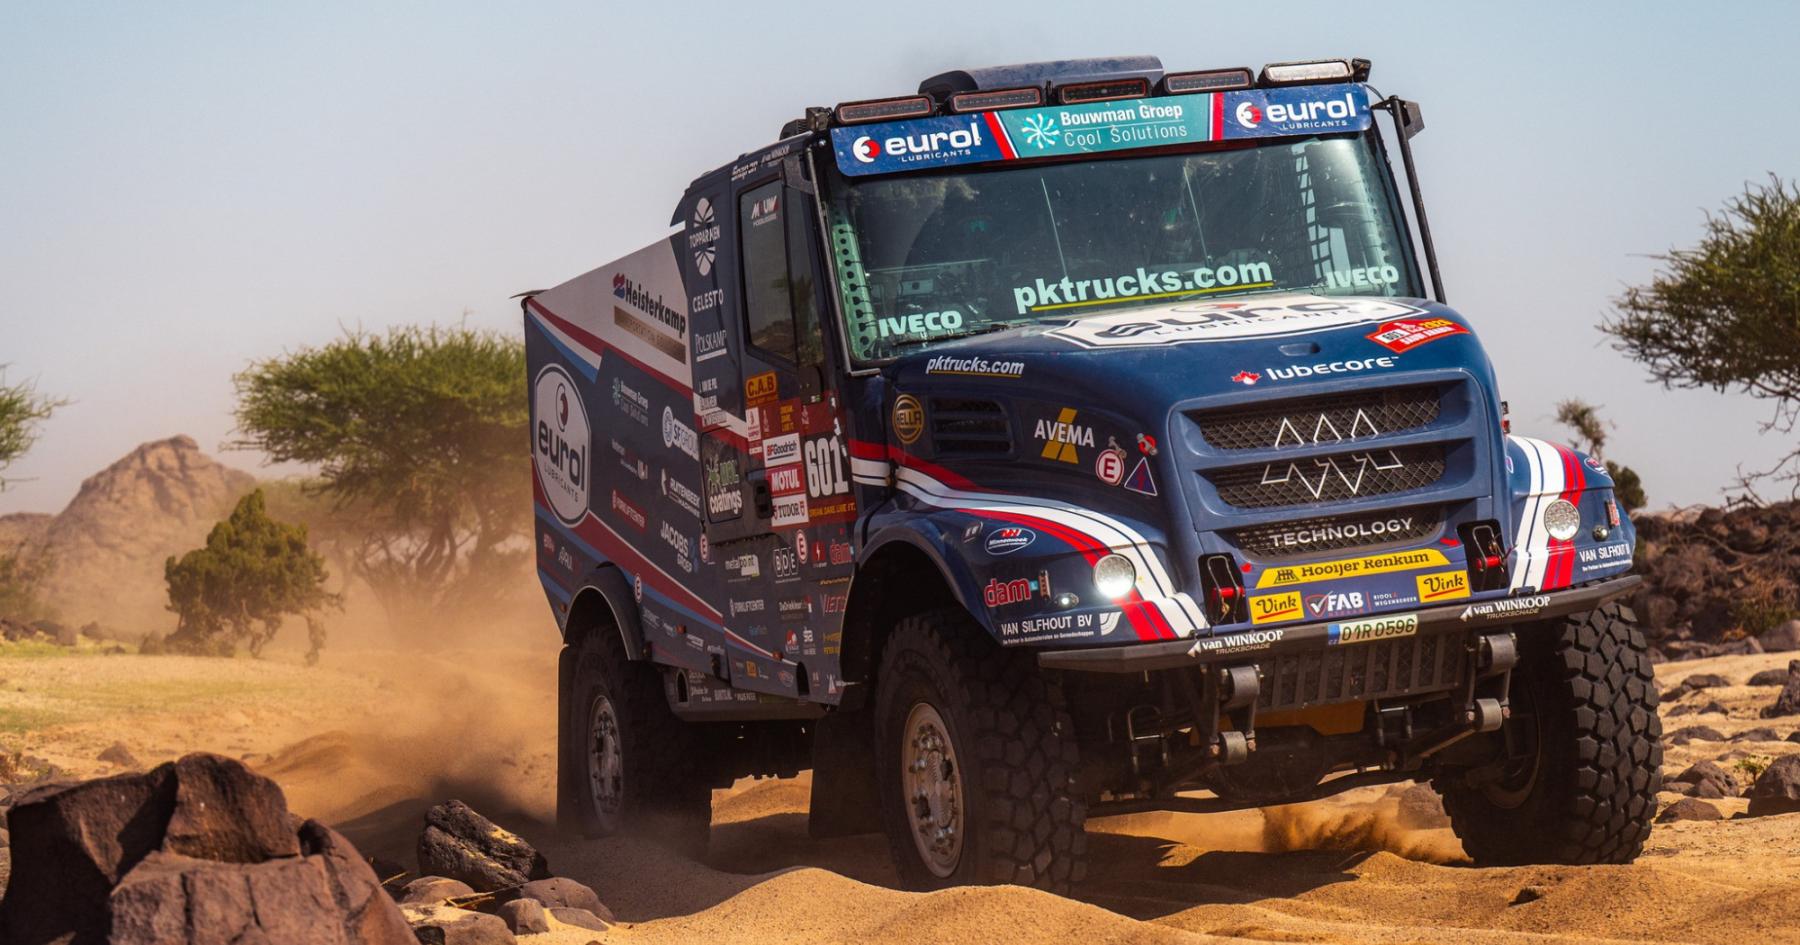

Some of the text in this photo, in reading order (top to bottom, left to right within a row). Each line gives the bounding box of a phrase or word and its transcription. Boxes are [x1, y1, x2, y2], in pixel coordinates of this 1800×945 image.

[1060, 104, 1183, 126] Bouwman Groep
[1266, 93, 1357, 122] eurol
[1064, 124, 1188, 147] Cool Solutions
[1281, 120, 1348, 130] LUBRICANTS
[885, 122, 982, 156] eurol
[901, 149, 971, 162] LUBRICANTS
[689, 225, 721, 248] TOPPARKEN
[1013, 262, 1273, 314] pktrucks.com
[1326, 265, 1400, 289] IVECO
[625, 279, 686, 339] Heisterkamp
[692, 289, 724, 313] CELESTO
[878, 310, 963, 337] IVECO
[926, 355, 1025, 374] pktrucks.com
[1034, 419, 1095, 448] AVEMA
[539, 420, 586, 491] eurol
[804, 436, 849, 498] 601
[771, 469, 800, 492] MOTUL
[710, 487, 742, 515] coatings
[778, 502, 800, 518] TUDOR
[661, 520, 688, 558] JACOBS
[1269, 518, 1413, 547] TECHNOLOGY
[1301, 562, 1360, 578] Hooijer
[1363, 553, 1430, 569] Renkum
[1579, 549, 1597, 563] VAN
[985, 578, 1031, 607] dam
[1424, 574, 1464, 593] Vink
[1256, 596, 1297, 614] Vink
[1328, 592, 1363, 611] FAB
[1473, 596, 1551, 615] van WINKOOP
[1001, 614, 1093, 636] VAN SILFHOUT BV
[1375, 618, 1415, 637] 0596
[1202, 630, 1284, 651] van WINKOOP
